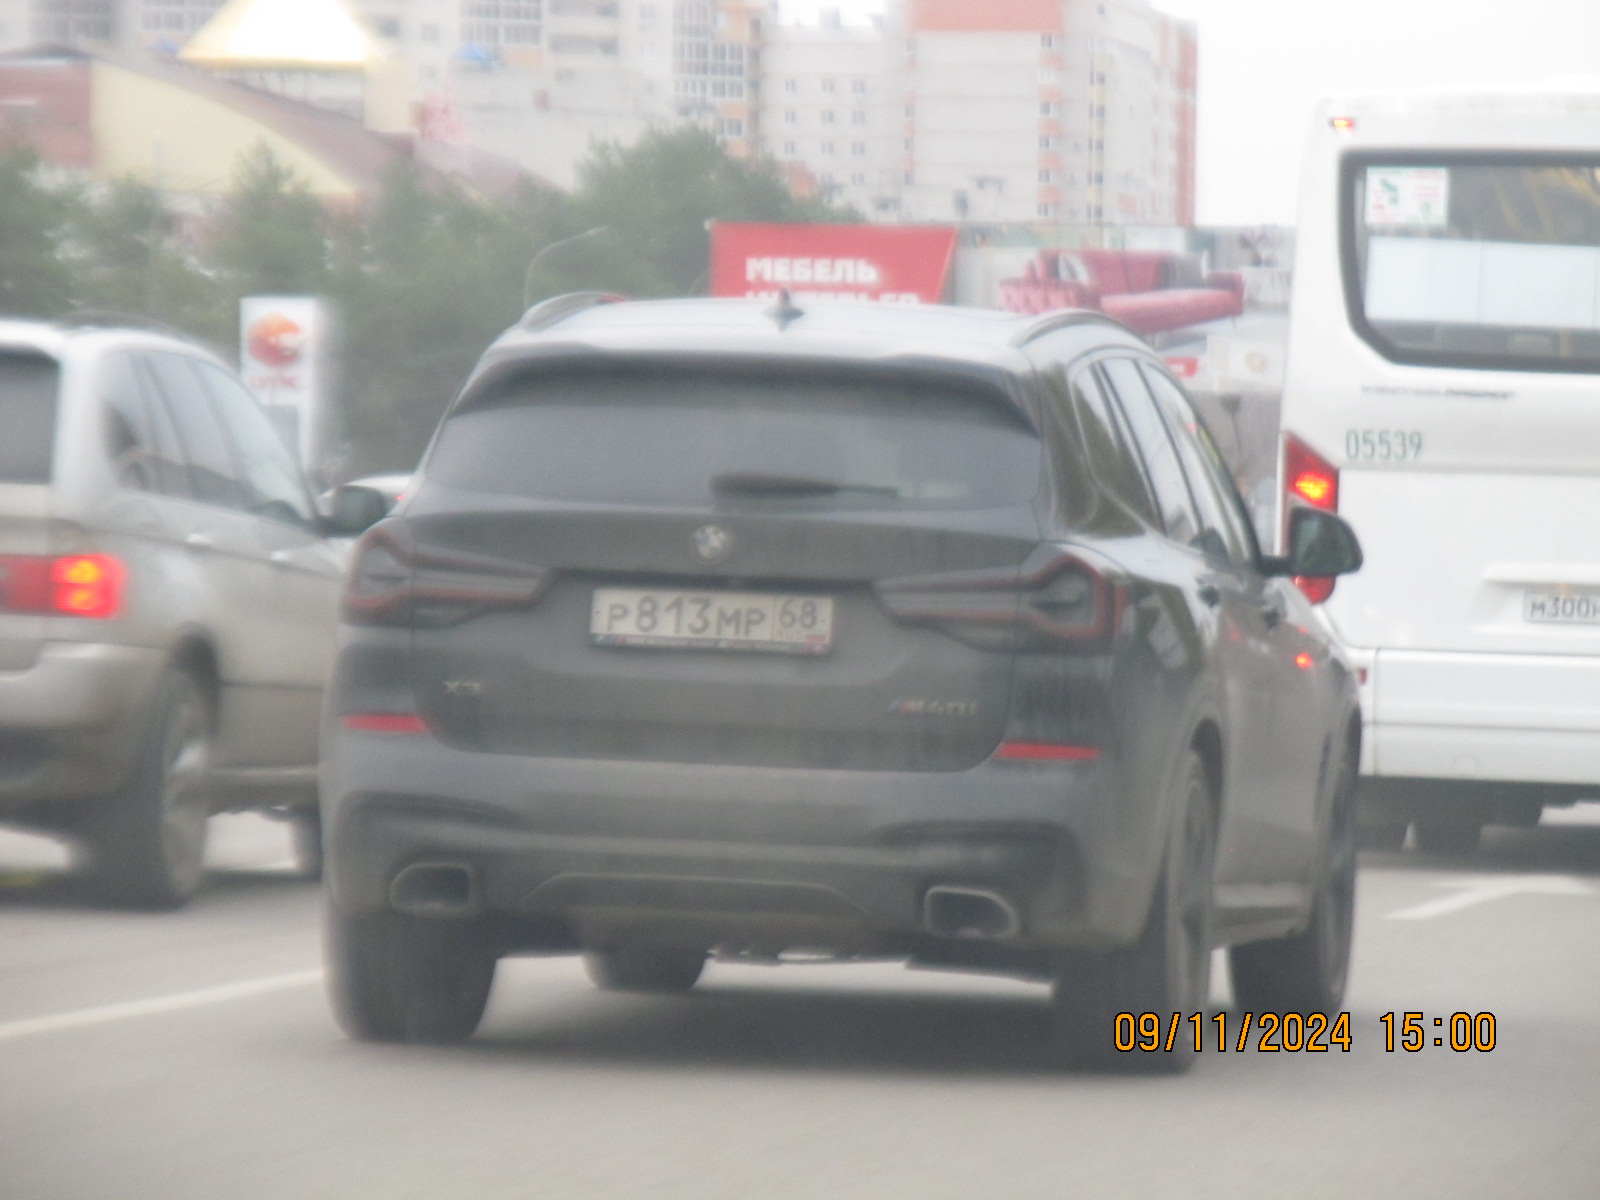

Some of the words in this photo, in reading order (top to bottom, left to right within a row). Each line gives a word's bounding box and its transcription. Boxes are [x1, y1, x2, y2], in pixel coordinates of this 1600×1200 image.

[745, 257, 880, 284] МЕБЕЛЬ
[1345, 429, 1424, 462] 05539
[778, 600, 818, 629] 68
